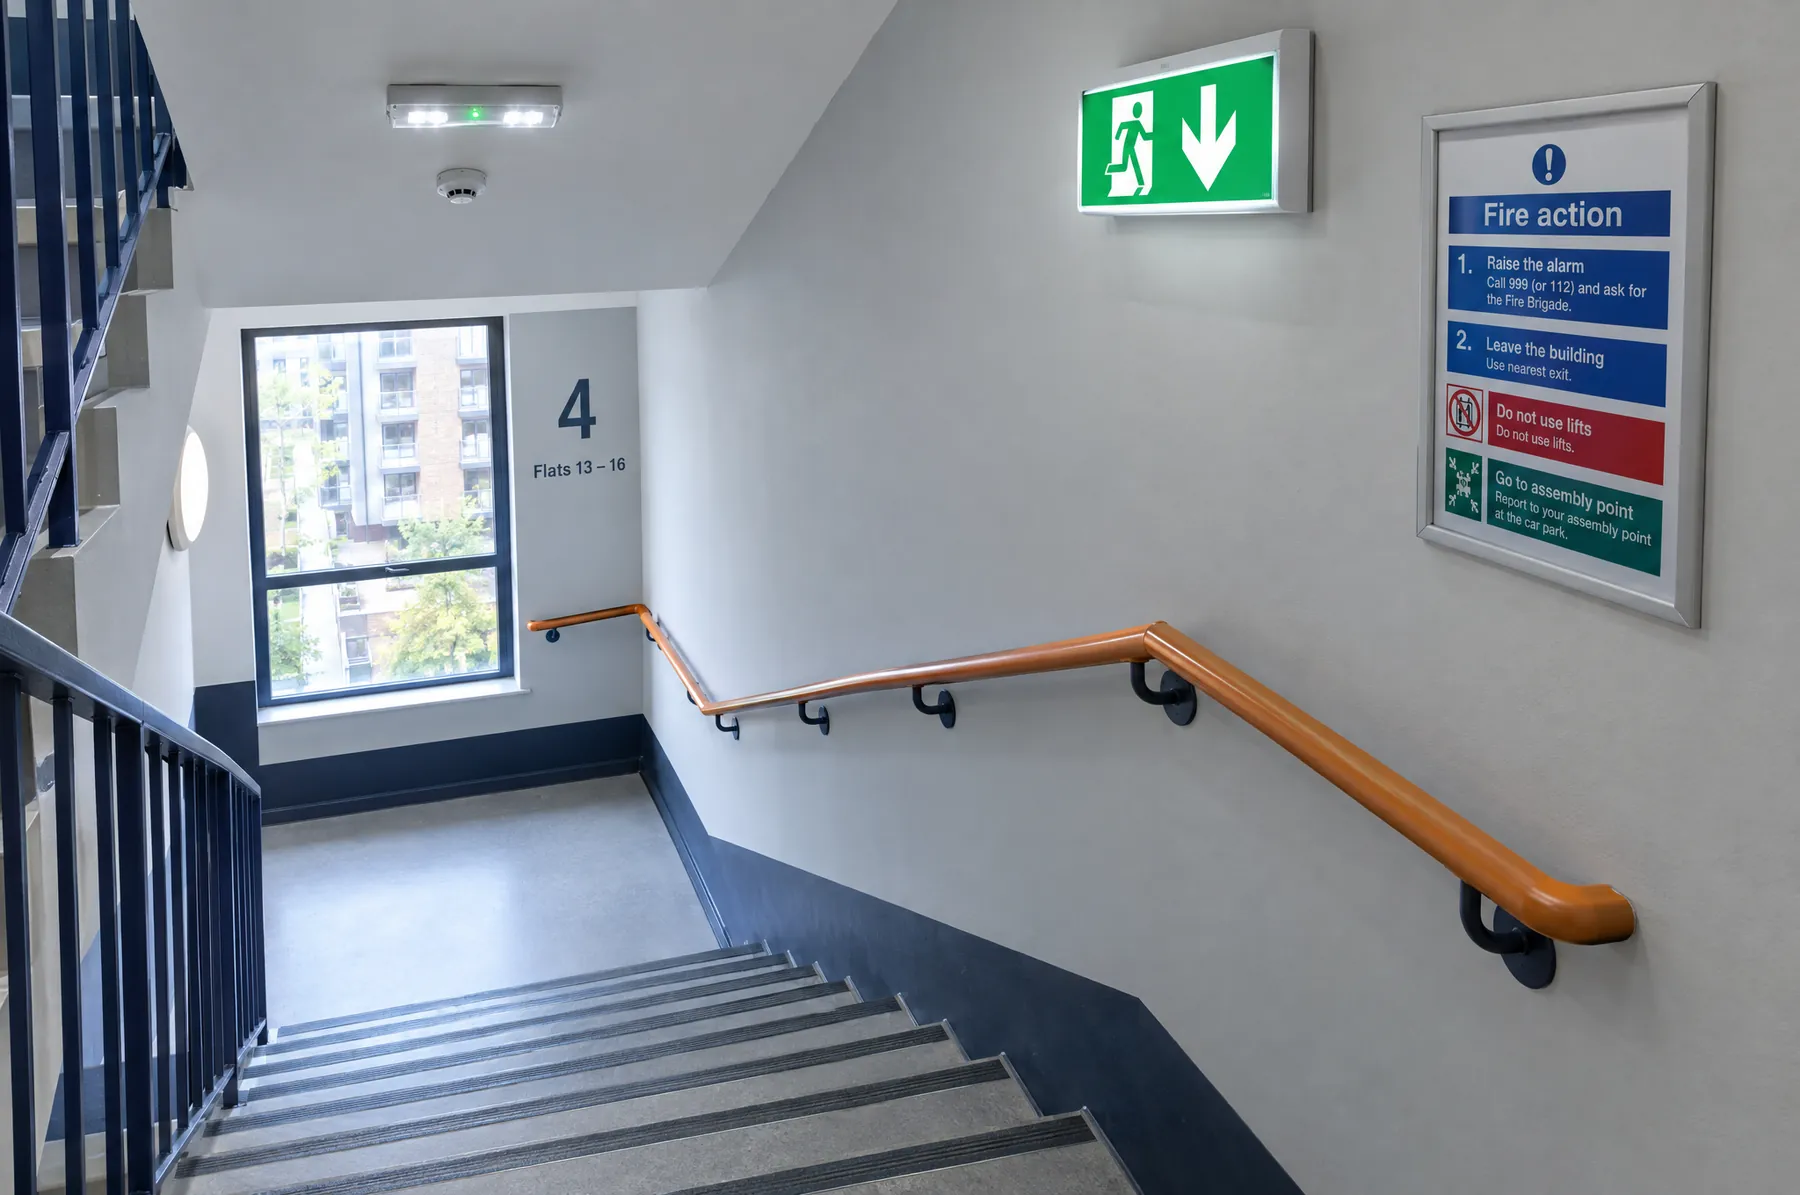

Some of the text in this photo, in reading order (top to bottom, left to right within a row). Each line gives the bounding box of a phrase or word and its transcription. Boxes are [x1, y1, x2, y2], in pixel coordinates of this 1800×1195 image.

[1484, 201, 1622, 227] Fire action
[1458, 254, 1584, 274] 1. Raise the alarm
[1487, 277, 1646, 298] Call 999 (or 112) and ask for
[1487, 294, 1571, 312] the Fire Brigade.
[1456, 330, 1604, 369] 2. Leave the building
[1487, 358, 1571, 381] Use nearest exit.
[558, 379, 596, 439] 4
[1497, 404, 1592, 436] Do not use lifts
[1497, 424, 1574, 453] Do not use lifts.
[534, 464, 571, 478] Flats
[576, 460, 592, 474] 13
[610, 458, 626, 471] 16
[1495, 471, 1633, 520] Go to assembly point
[1495, 491, 1651, 546] Report to your assembly point
[1495, 509, 1568, 539] at the car park.
